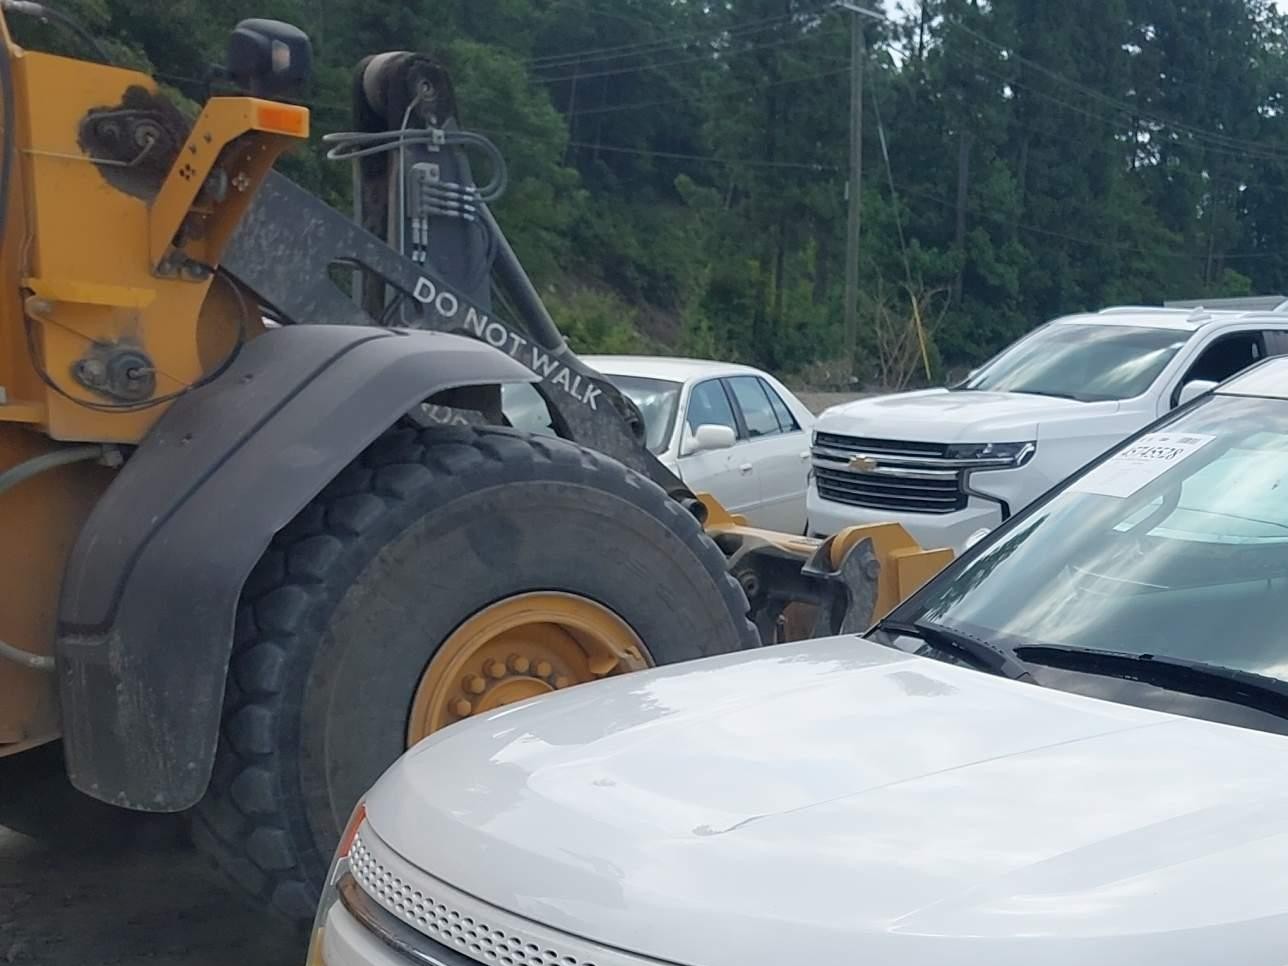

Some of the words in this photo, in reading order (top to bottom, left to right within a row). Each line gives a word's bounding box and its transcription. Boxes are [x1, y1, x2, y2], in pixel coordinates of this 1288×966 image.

[412, 276, 459, 318] DO
[463, 307, 527, 358] NOT
[530, 347, 603, 411] WALK
